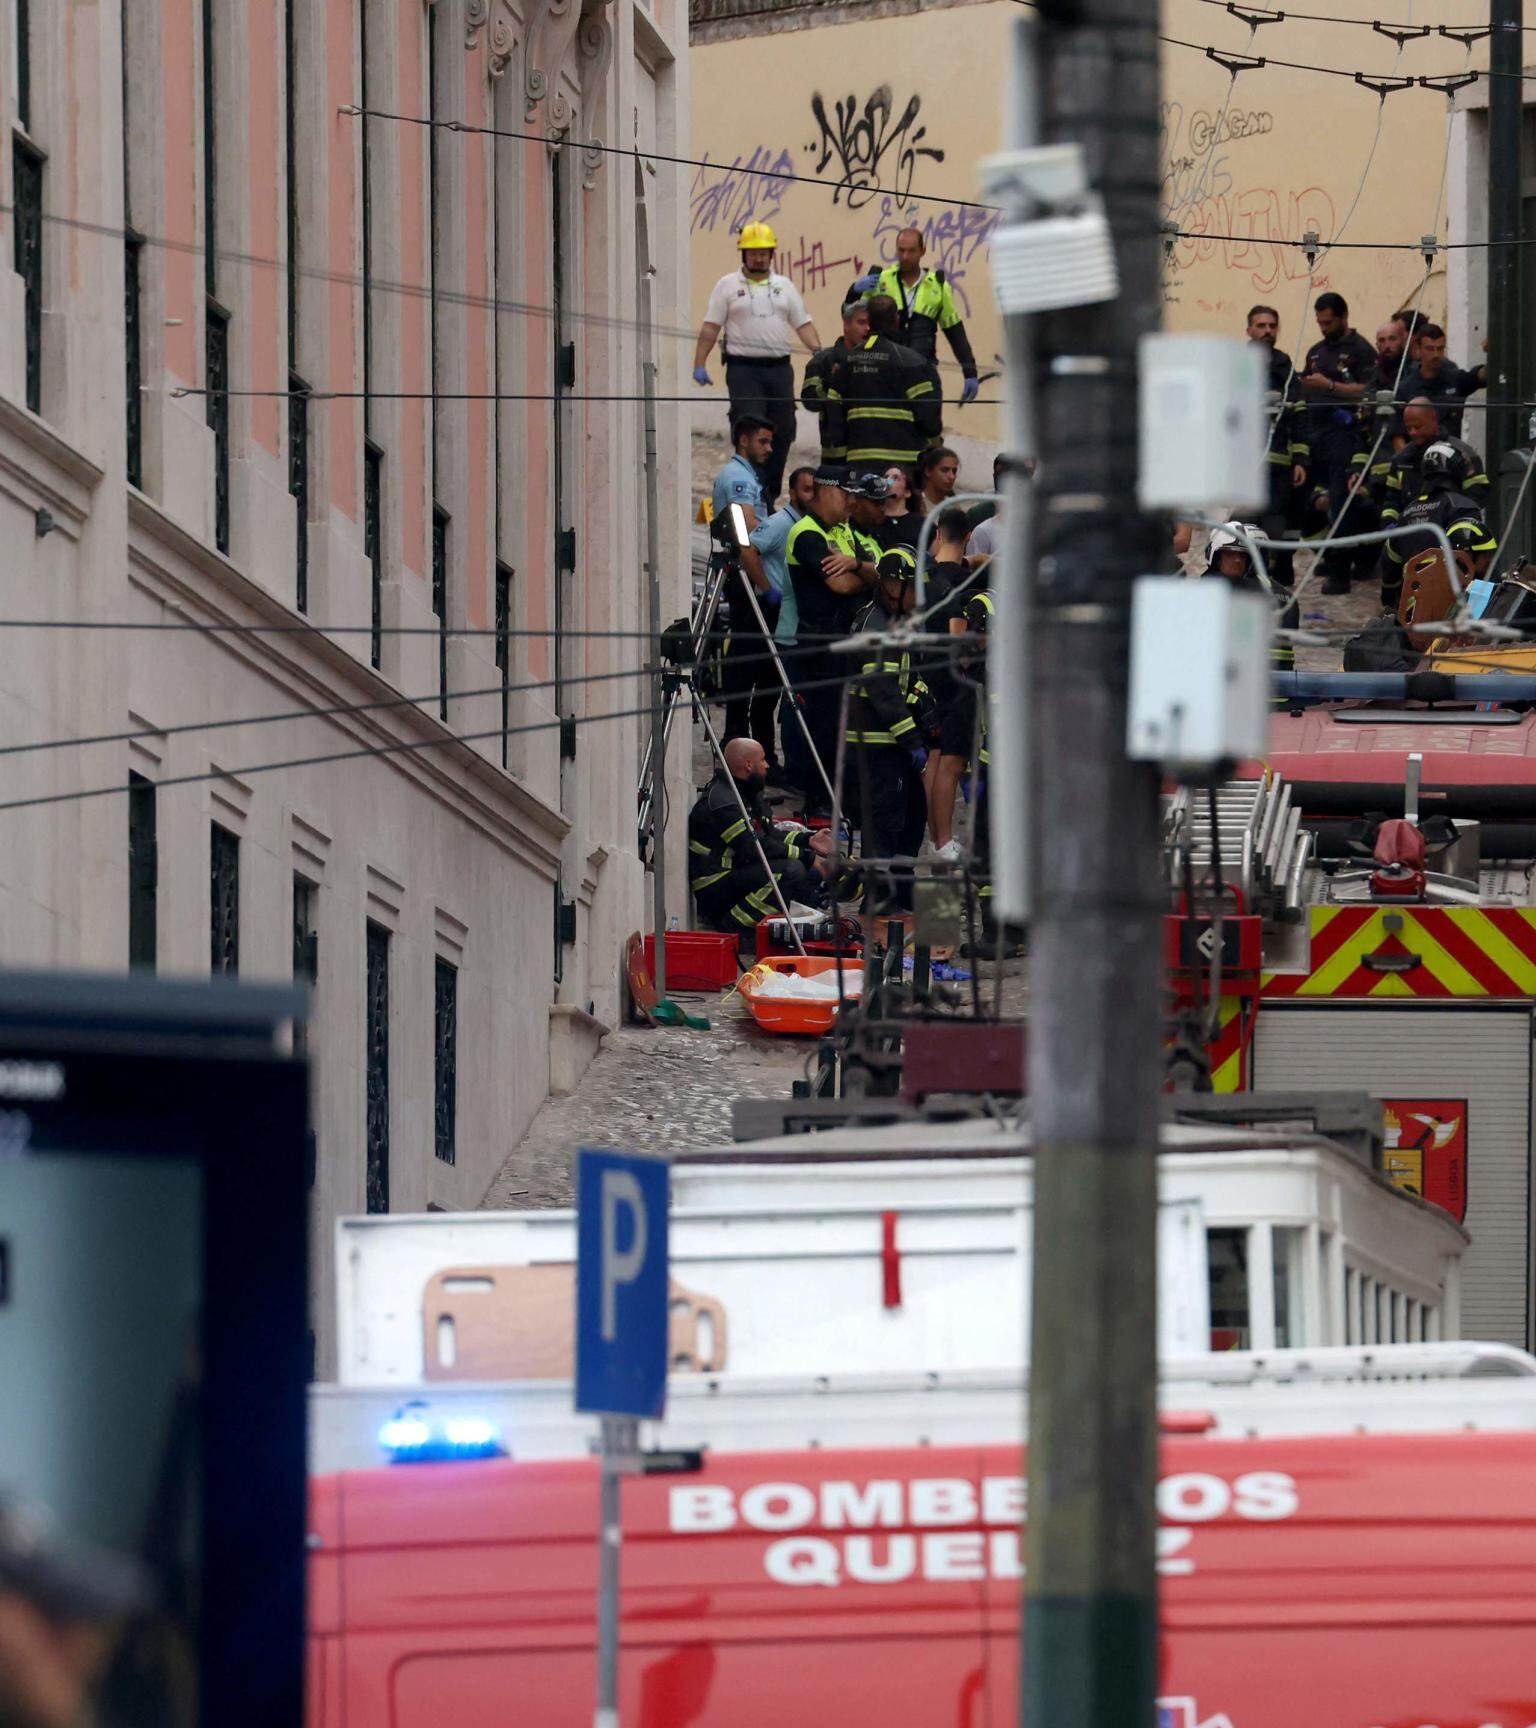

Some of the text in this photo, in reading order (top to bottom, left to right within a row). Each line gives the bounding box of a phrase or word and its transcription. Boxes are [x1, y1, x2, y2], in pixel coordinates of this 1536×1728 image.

[600, 1169, 648, 1342] P
[669, 1472, 1299, 1533] BOMBEOS
[765, 1528, 1196, 1586] QUELZ
